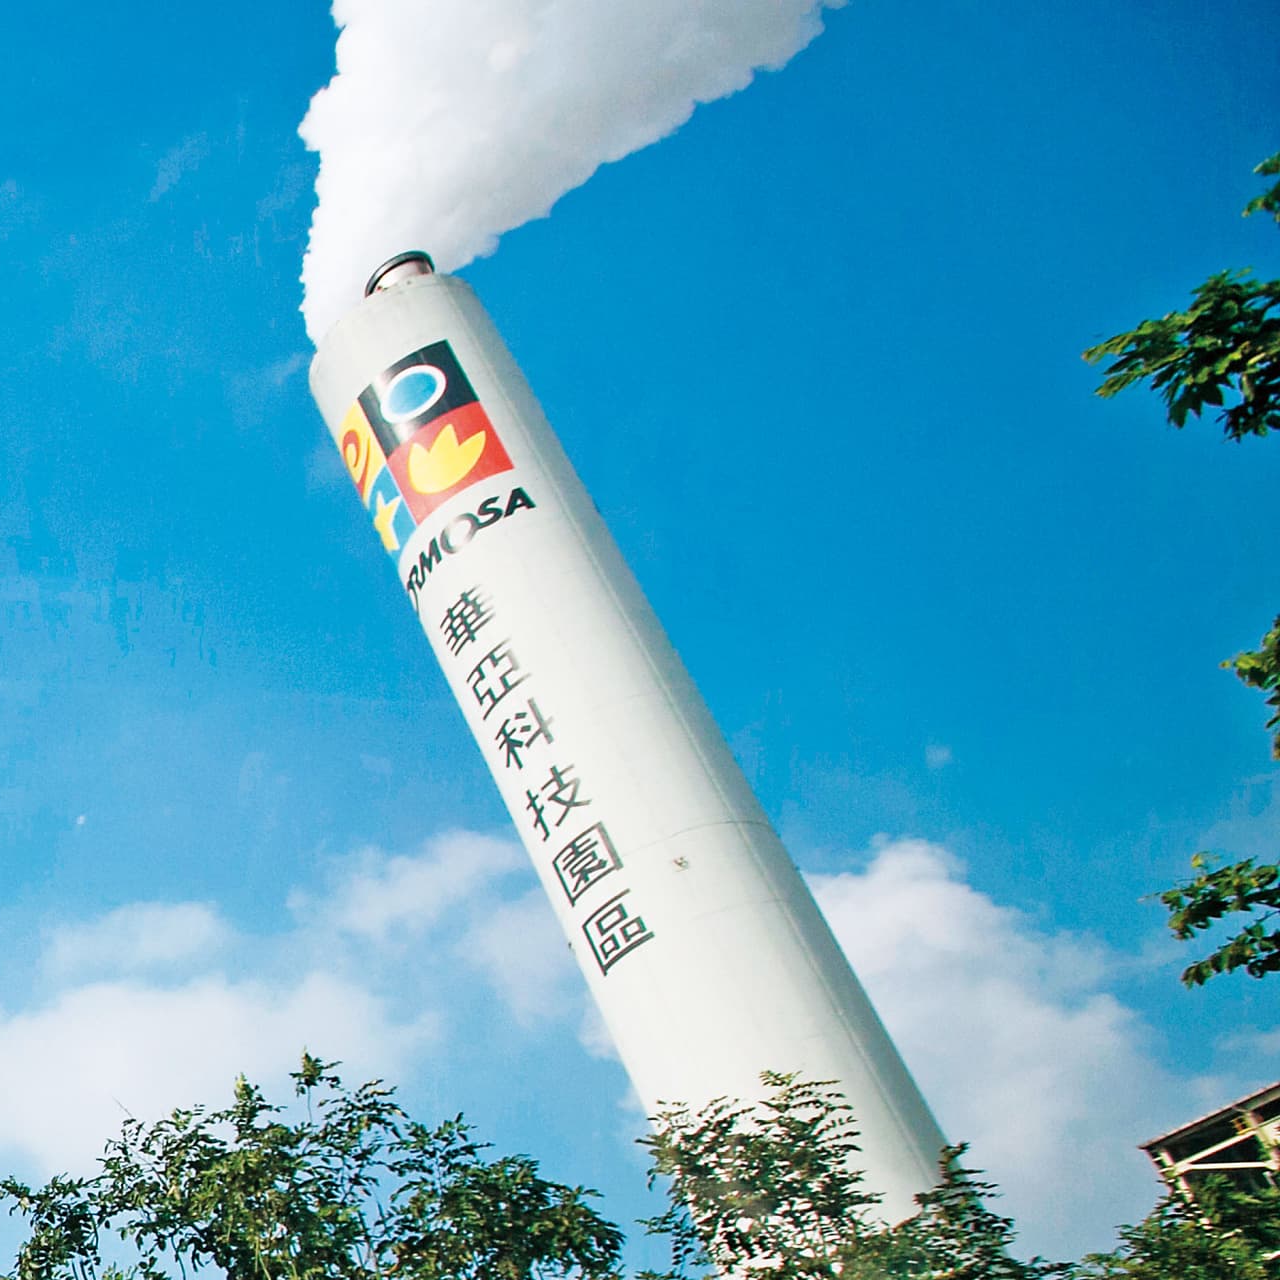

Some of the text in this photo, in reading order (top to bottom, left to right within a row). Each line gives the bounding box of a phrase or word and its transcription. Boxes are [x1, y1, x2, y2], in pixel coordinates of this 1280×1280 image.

[406, 486, 536, 619] RMOSA
[440, 584, 654, 976] 華亞科技園區
